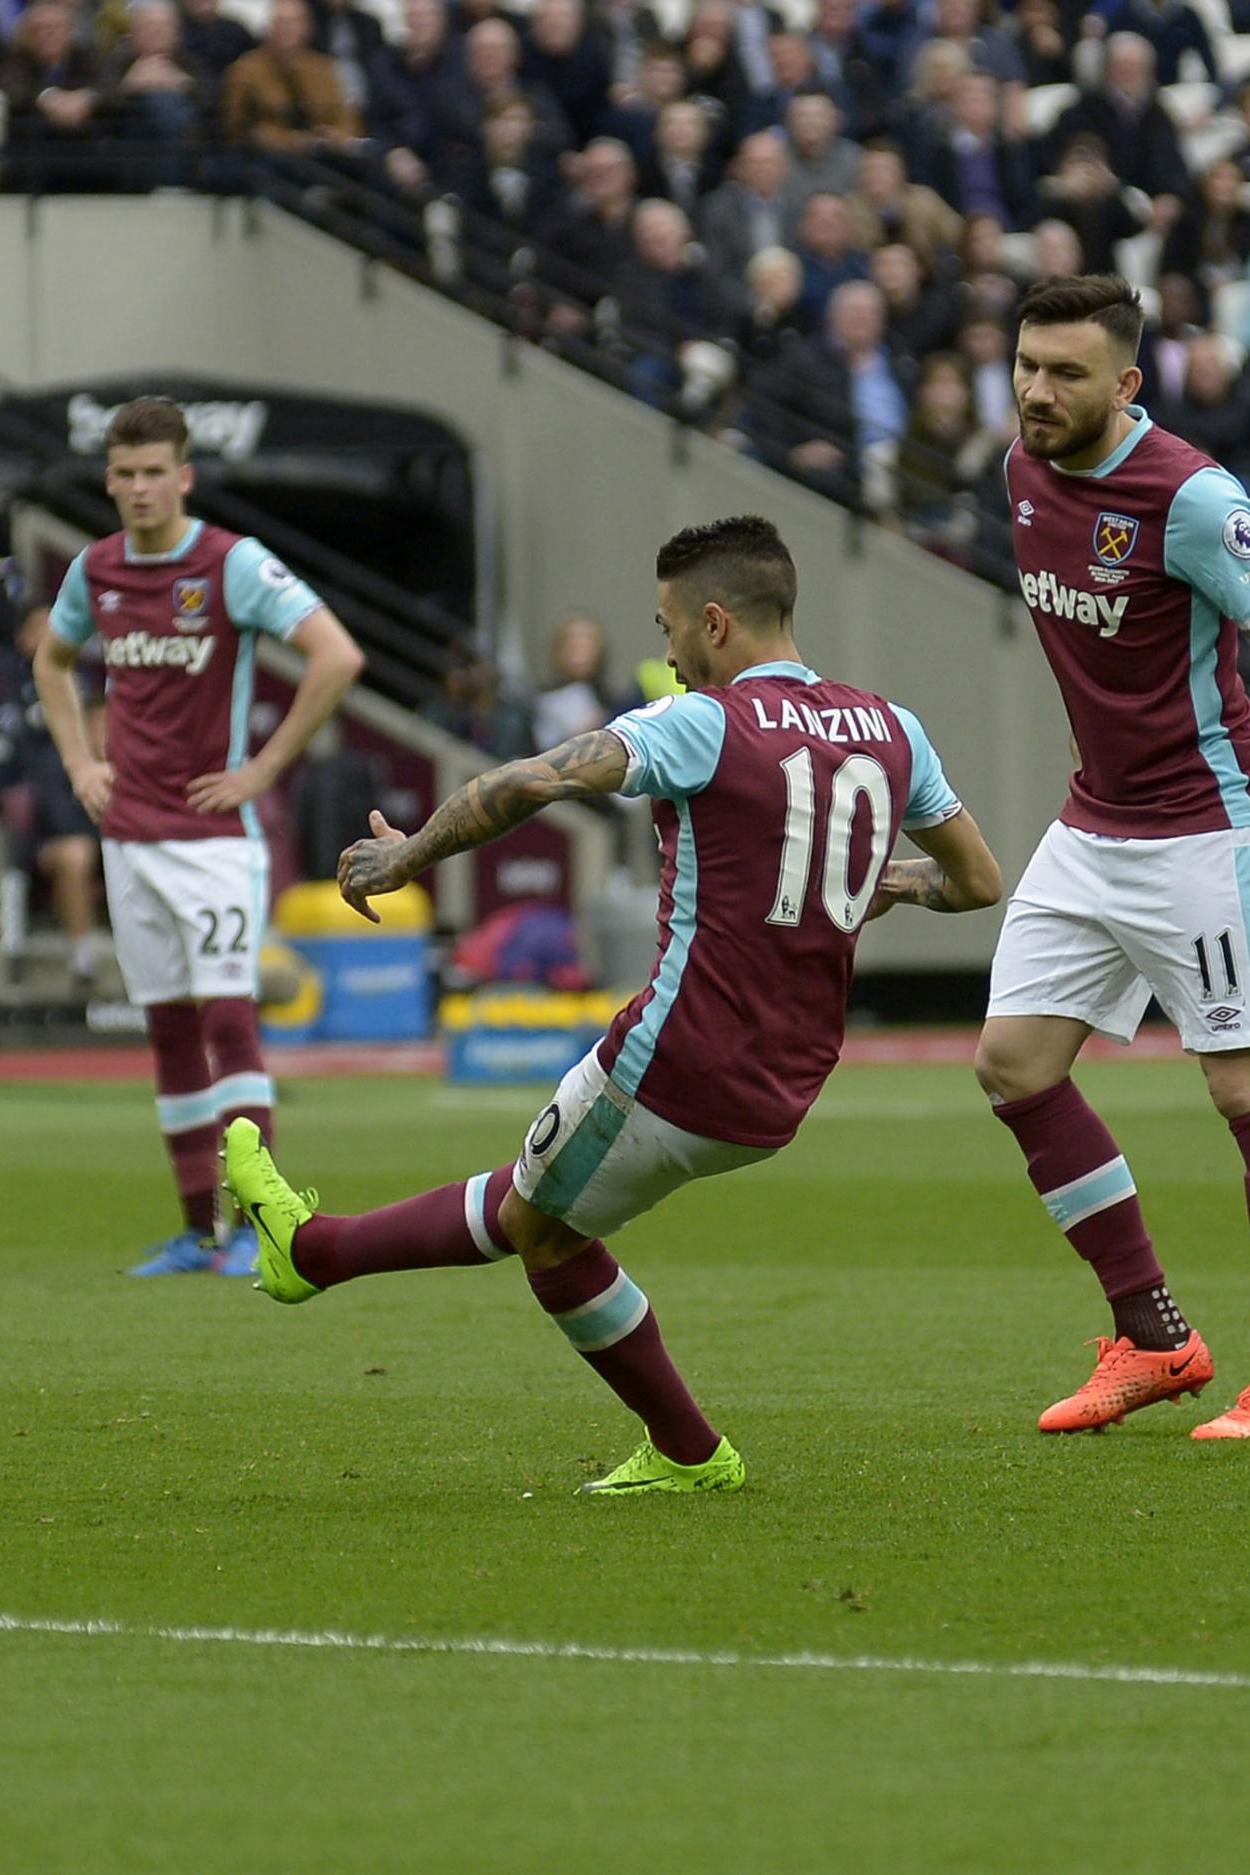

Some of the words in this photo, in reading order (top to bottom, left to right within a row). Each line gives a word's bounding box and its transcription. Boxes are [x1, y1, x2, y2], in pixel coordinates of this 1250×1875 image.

[68, 393, 268, 462] bay
[1018, 569, 1130, 637] etway
[752, 698, 892, 743] LANZINI
[764, 745, 892, 934] 10
[198, 906, 249, 955] 22
[1190, 927, 1242, 1003] 11
[1211, 1022, 1242, 1032] umbro
